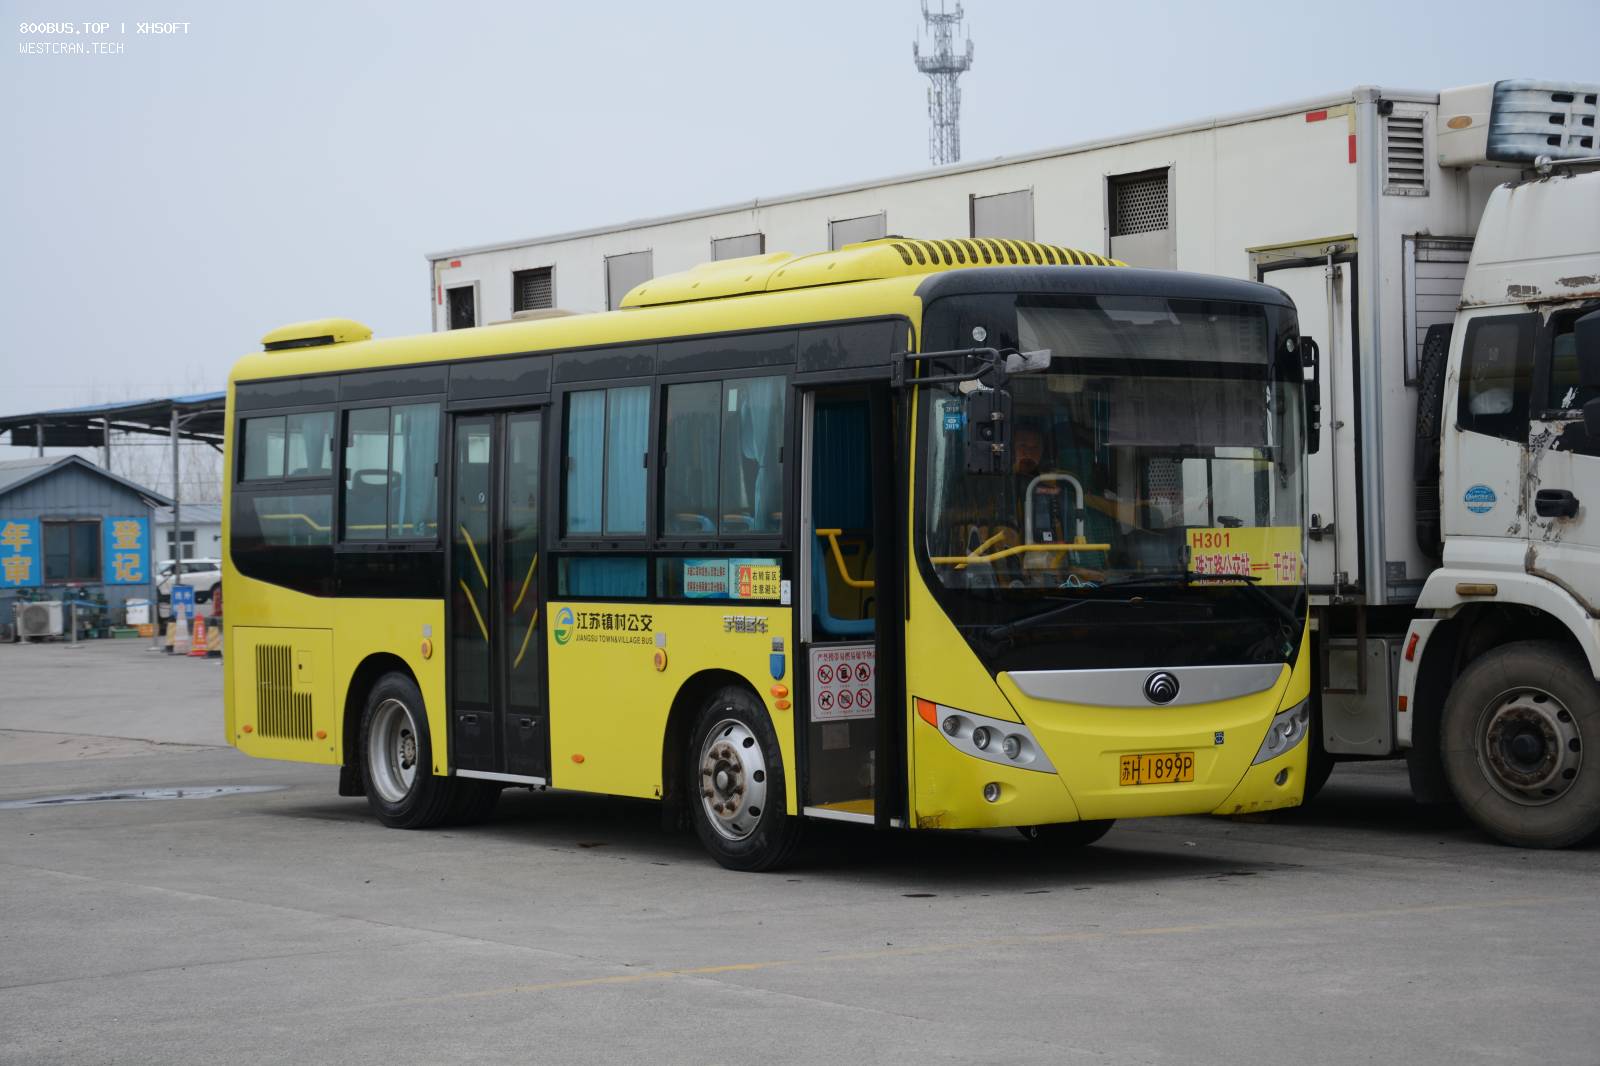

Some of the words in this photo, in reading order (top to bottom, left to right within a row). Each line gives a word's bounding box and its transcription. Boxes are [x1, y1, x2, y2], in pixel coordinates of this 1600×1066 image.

[112, 520, 142, 581] 登记
[1192, 532, 1231, 549] H301
[1, 521, 32, 586] 年审
[576, 612, 653, 632] 江苏镇村公交
[641, 637, 653, 645] BUS
